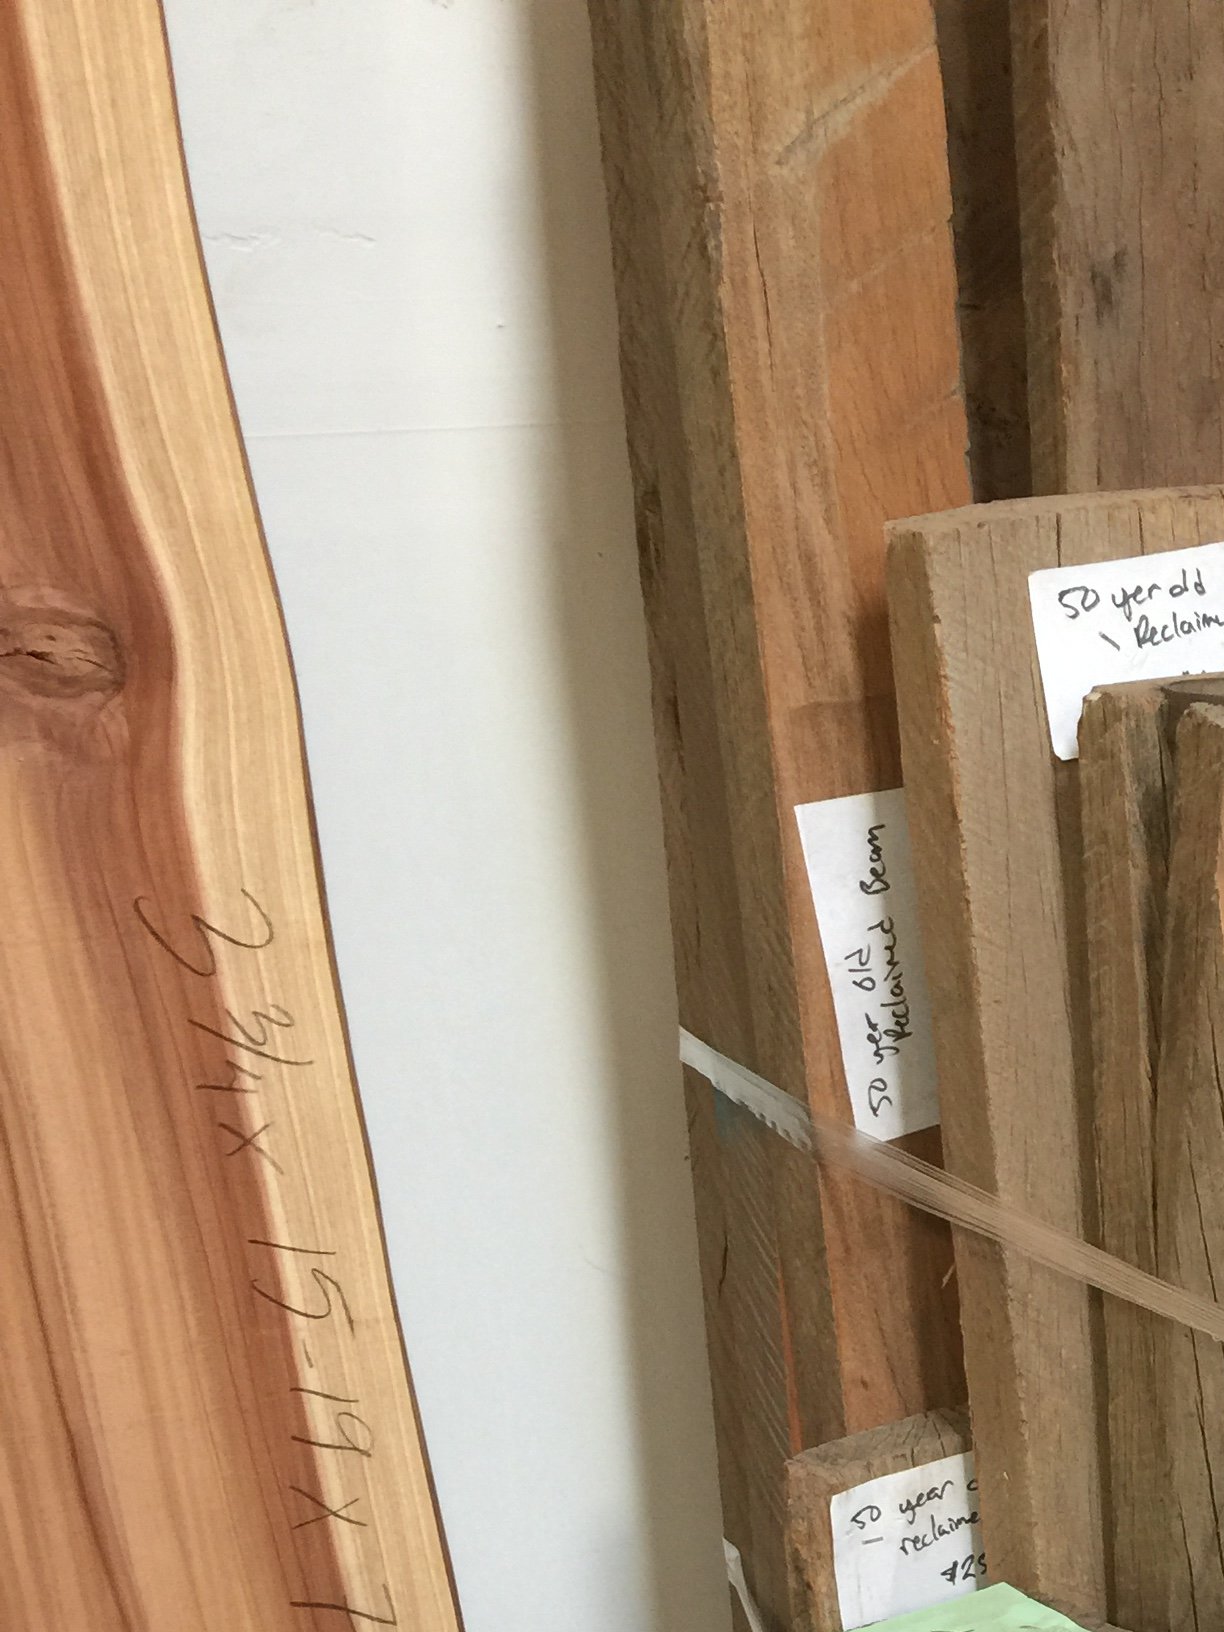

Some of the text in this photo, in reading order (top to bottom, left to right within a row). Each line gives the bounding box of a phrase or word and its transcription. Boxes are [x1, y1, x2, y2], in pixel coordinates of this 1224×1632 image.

[1058, 586, 1100, 619] 50
[868, 1077, 893, 1117] 50
[851, 1480, 953, 1529] 50 year
